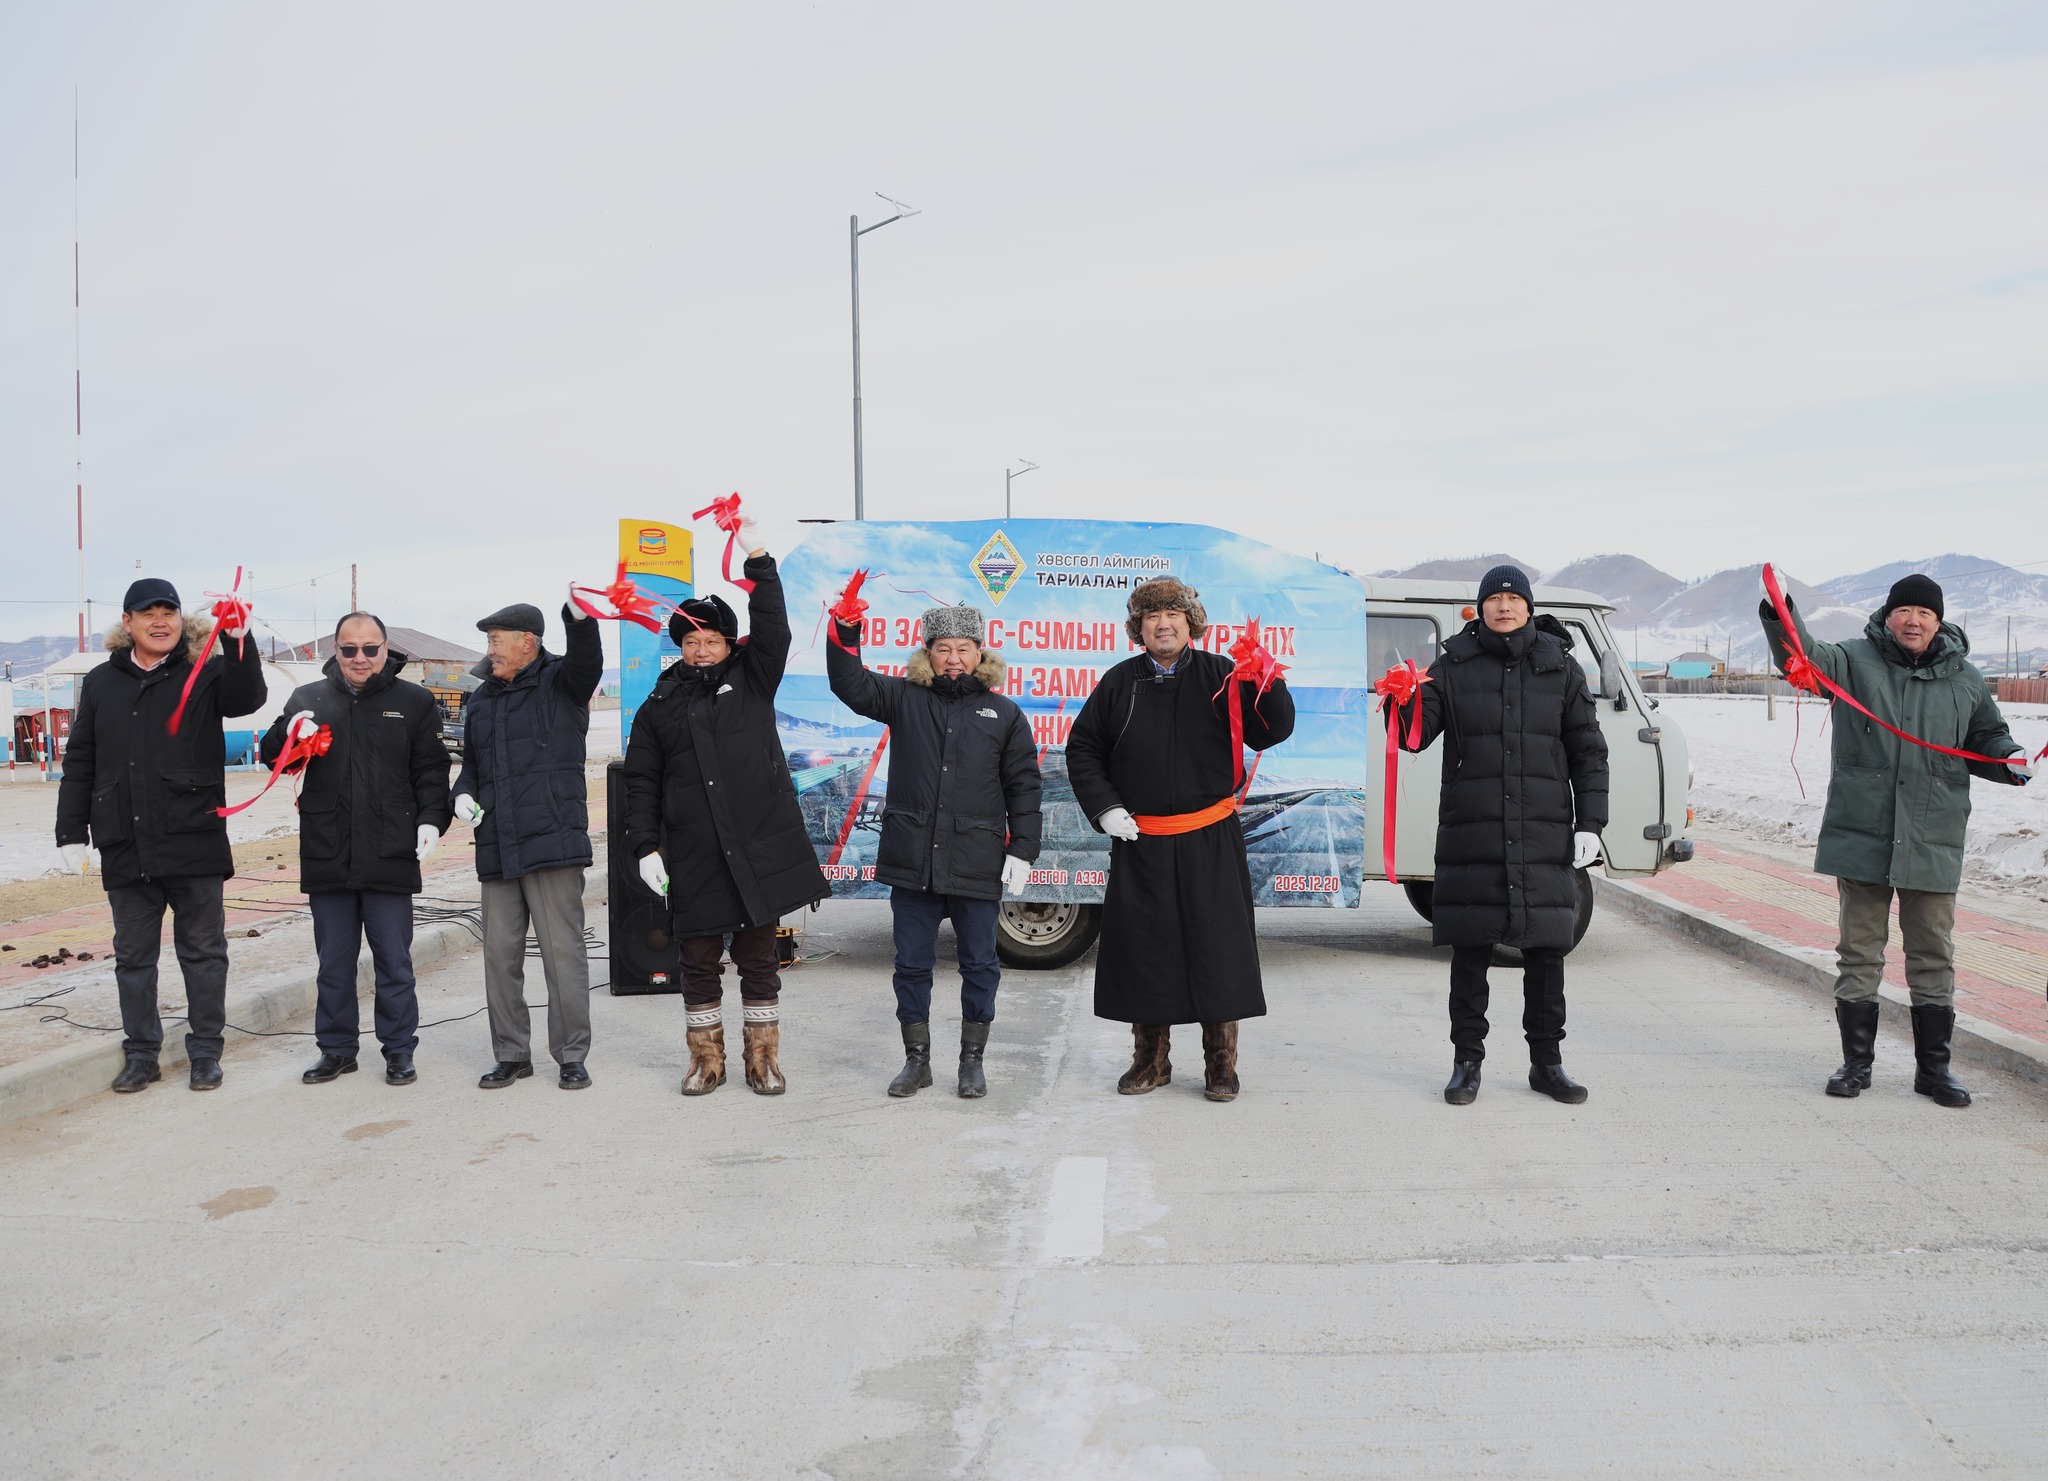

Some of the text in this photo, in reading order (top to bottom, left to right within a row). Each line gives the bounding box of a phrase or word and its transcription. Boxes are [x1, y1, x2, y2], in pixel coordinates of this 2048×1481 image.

[1037, 554, 1170, 570] ХӨВСГӨЛ АЙМГИЙН
[1036, 572, 1128, 589] ТАРИАЛАН
[1275, 875, 1339, 891] 2025.12.20
